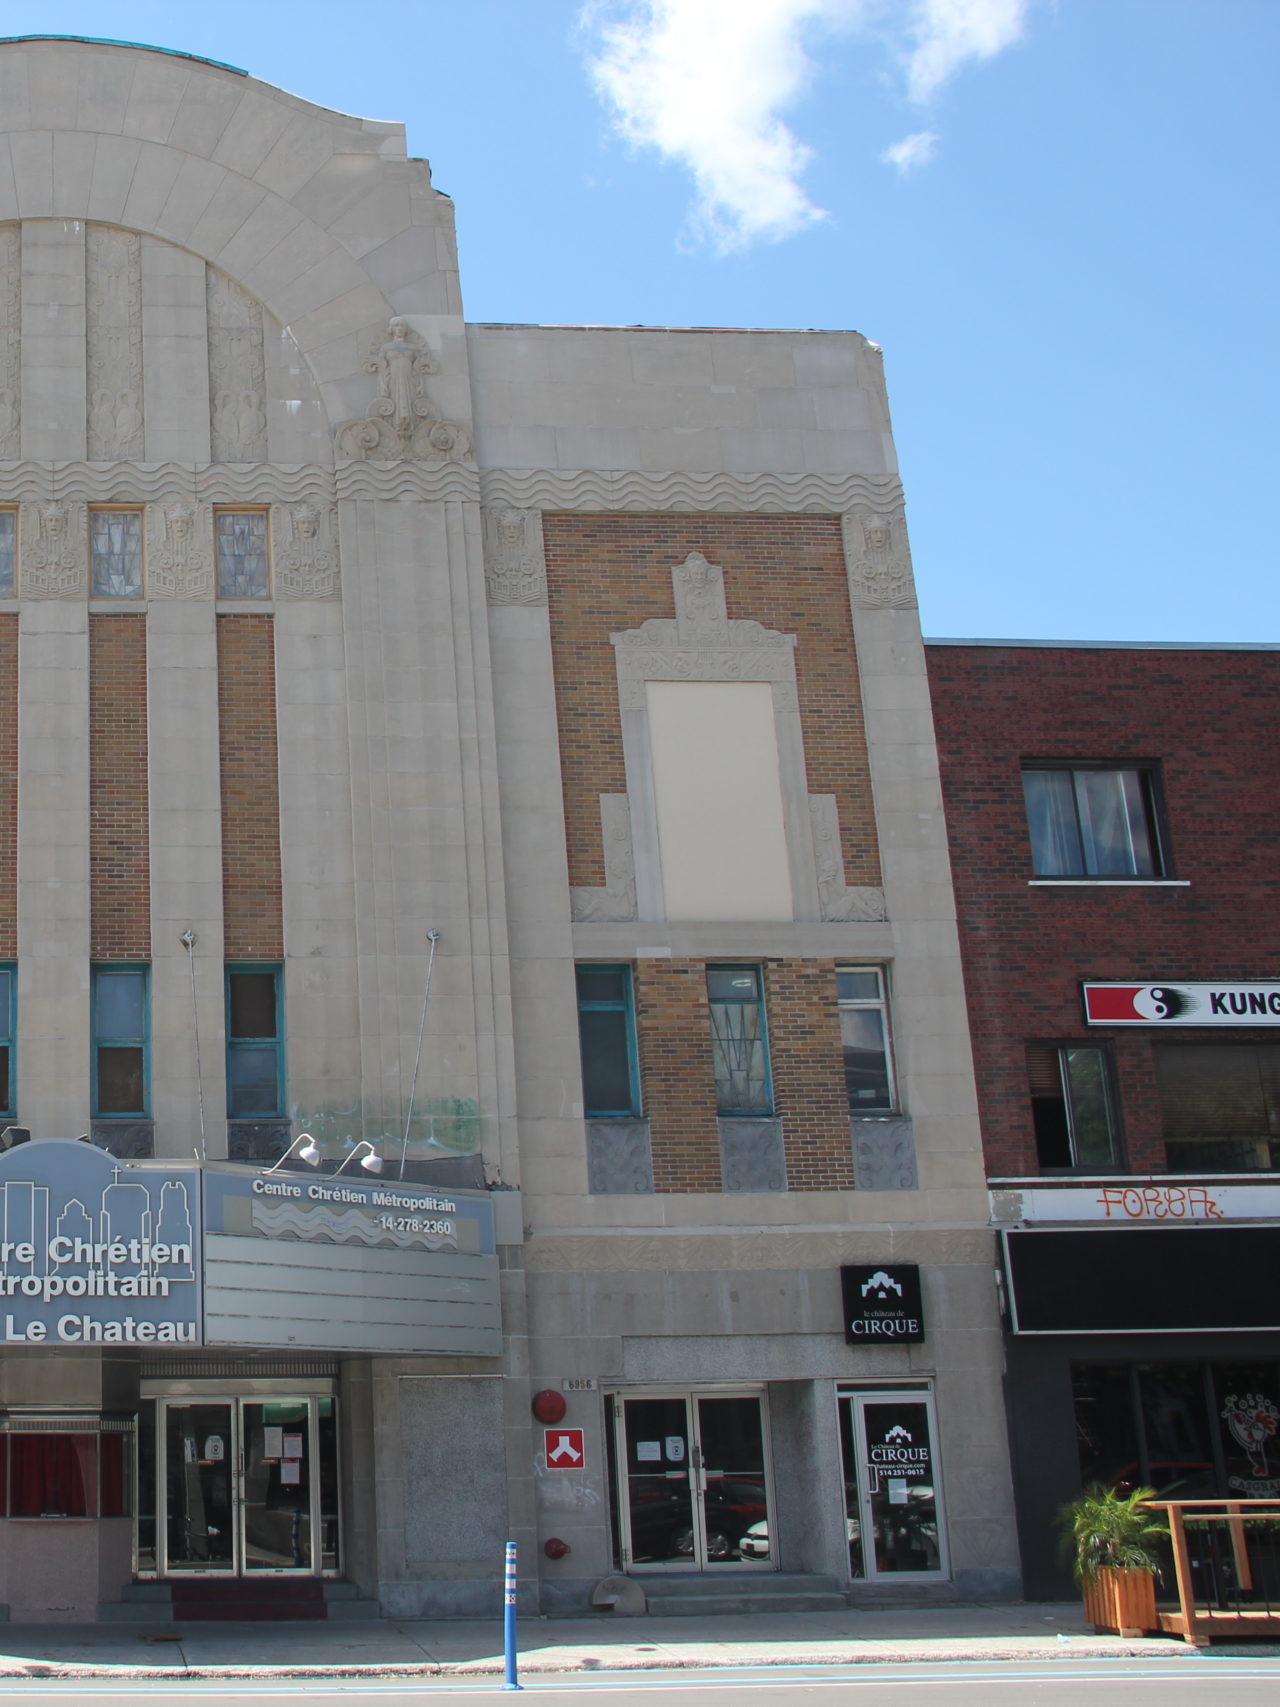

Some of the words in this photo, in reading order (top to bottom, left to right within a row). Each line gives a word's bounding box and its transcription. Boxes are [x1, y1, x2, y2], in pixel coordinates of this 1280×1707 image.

[1209, 992, 1280, 1015] KUNG
[252, 1179, 302, 1198] Centre
[308, 1184, 367, 1205] Chrétien
[372, 1191, 457, 1214] Métropolitain
[48, 1236, 191, 1265] Chrétien
[6, 1314, 48, 1342] Le
[57, 1314, 197, 1343] Chateau
[851, 1319, 919, 1336] CIRQUE
[871, 1448, 929, 1463] CIRQUE
